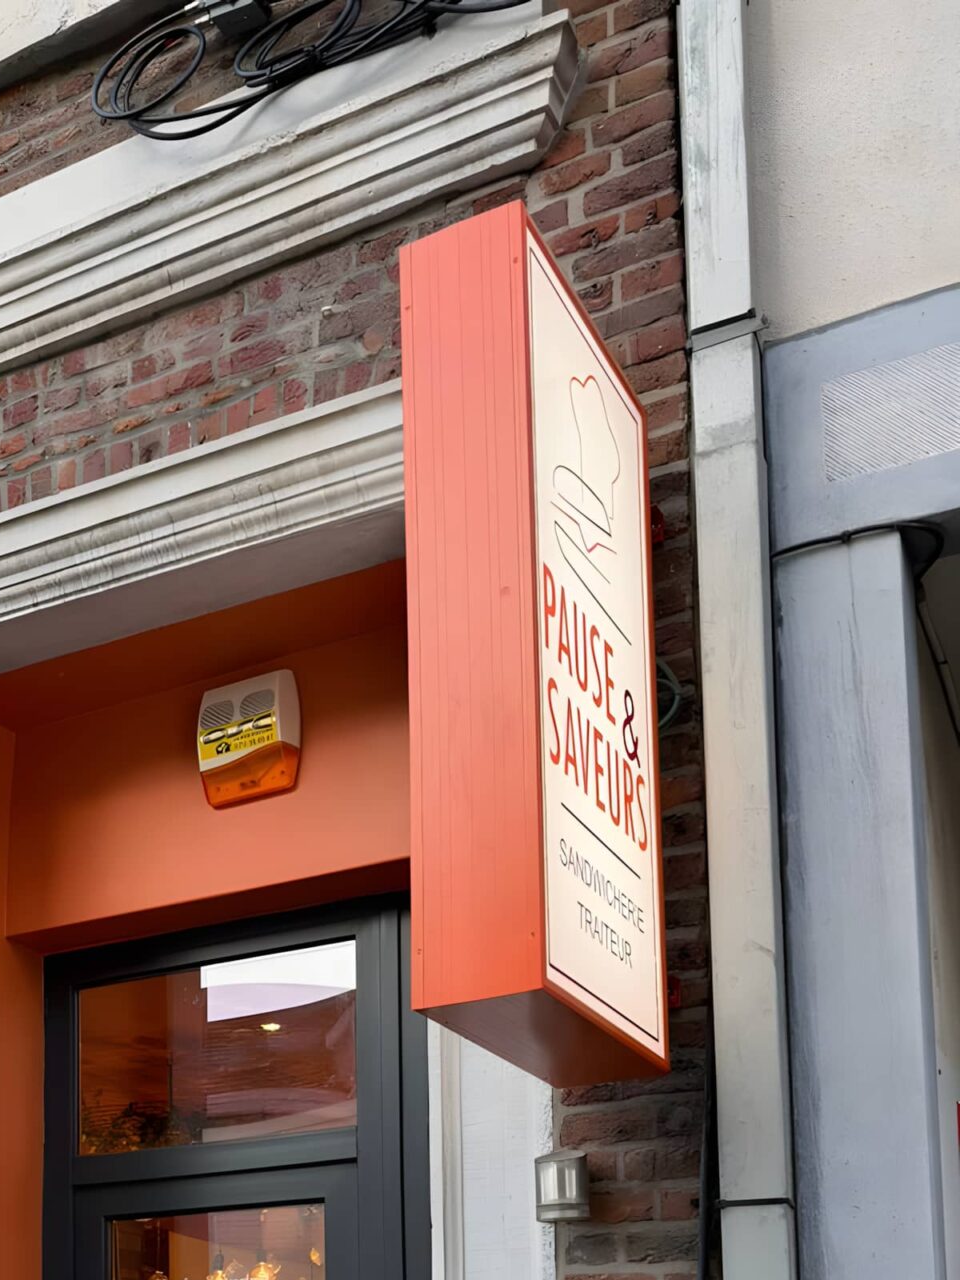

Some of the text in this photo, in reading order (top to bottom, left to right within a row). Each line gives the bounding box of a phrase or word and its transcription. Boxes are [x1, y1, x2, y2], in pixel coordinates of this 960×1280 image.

[543, 561, 641, 768] PAUSE &
[547, 677, 648, 852] SAVEURS
[560, 838, 644, 934] SANDWICHERIE
[577, 901, 632, 969] TRAITEUR
